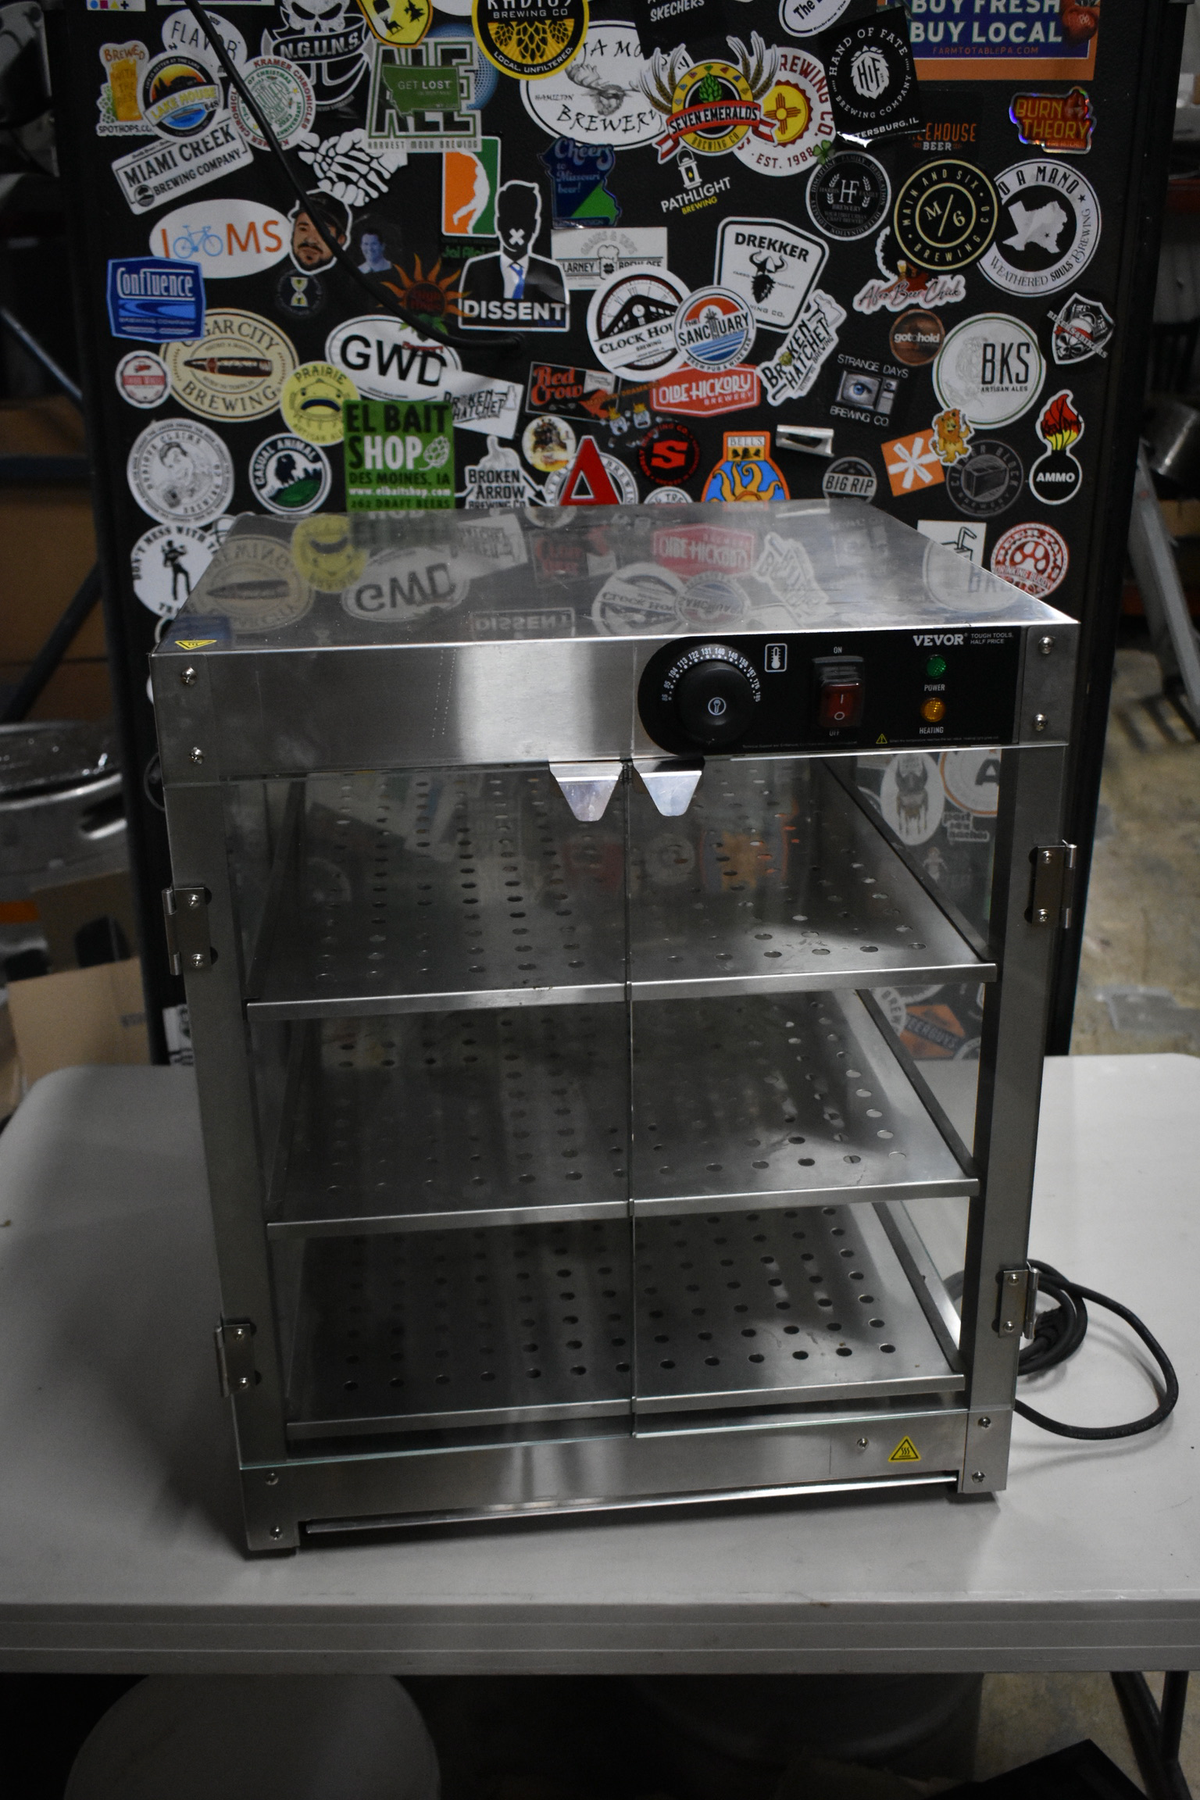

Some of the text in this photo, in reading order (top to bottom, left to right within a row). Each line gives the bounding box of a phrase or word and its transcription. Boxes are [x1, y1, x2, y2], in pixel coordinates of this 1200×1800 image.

[493, 8, 568, 19] BREWING CO
[650, 0, 705, 21] SKECHERS
[793, 0, 816, 20] The
[910, 0, 1060, 13] BUY FRESH
[171, 20, 238, 61] FLAVR
[910, 21, 966, 43] BUY
[972, 20, 1062, 43] LOCAL
[104, 44, 146, 62] BREWED
[493, 47, 574, 73] LOCAL. UNFILTERED.
[829, 27, 908, 76] HAND OF FATE
[398, 80, 452, 90] GET LOST
[779, 54, 830, 104] REWING
[151, 95, 180, 120] LAKE
[180, 86, 217, 106] HOUSE
[253, 58, 293, 71] KRAMER
[292, 67, 313, 130] CHRONICLES
[835, 75, 912, 119] BREWING COMPANY
[669, 105, 758, 134] SEVEN EMERALDS
[1015, 99, 1062, 118] BURN
[728, 132, 740, 141] CO
[855, 117, 919, 138] TERSBURG, IL
[1021, 118, 1090, 139] THEORY
[123, 150, 178, 188] MIAMI
[178, 124, 237, 162] CREEK
[554, 137, 614, 171] Cheers
[922, 142, 952, 151] BEER
[756, 147, 813, 170] EST. 1988
[153, 169, 197, 196] BREWING
[196, 148, 241, 177] COMPANY
[556, 169, 601, 182] Missouri
[1035, 166, 1080, 195] MANO
[660, 176, 732, 213] PATHLIGHT
[681, 195, 718, 215] BREWING
[902, 168, 980, 227] MAIN AND SIX
[226, 220, 283, 256] MS
[734, 232, 810, 263] DREKKER
[913, 234, 982, 262] BREWING
[990, 208, 1091, 287] WEATHERED SOULS BREWING
[117, 267, 195, 300] Confluence
[892, 279, 921, 307] Beer
[463, 300, 566, 321] DISSENT
[678, 312, 750, 347] SANCTUARY
[684, 318, 698, 327] THE
[237, 321, 281, 351] CITY
[599, 332, 647, 354] CLOCK
[339, 334, 447, 387] GWD
[837, 353, 909, 379] STRANGE DAYS
[981, 342, 1031, 385] BKS
[294, 366, 348, 385] PRAIRIE
[533, 366, 576, 387] Red
[182, 380, 280, 412] BREWING
[531, 383, 584, 406] Crow
[659, 383, 690, 404] OLDE
[690, 373, 751, 400] HICKORY
[703, 391, 753, 405] BREWERY
[347, 404, 450, 433] EL BAIT
[829, 405, 890, 428] BREWING CO
[256, 439, 319, 484] CASUAL ANIMAL
[349, 434, 423, 471] SHOP
[349, 472, 373, 485] DES
[436, 472, 451, 485] IA
[468, 469, 521, 485] BROKEN
[825, 474, 874, 494] BIG RIP
[1035, 472, 1076, 484] AMMO
[475, 485, 526, 500] ARROW
[145, 525, 206, 545] MESS WITH
[701, 647, 712, 656] 131
[833, 646, 843, 654] ON
[913, 634, 964, 647] VEVOR
[688, 650, 700, 660] 122
[924, 684, 946, 692] POWER
[919, 727, 944, 735] HEATING
